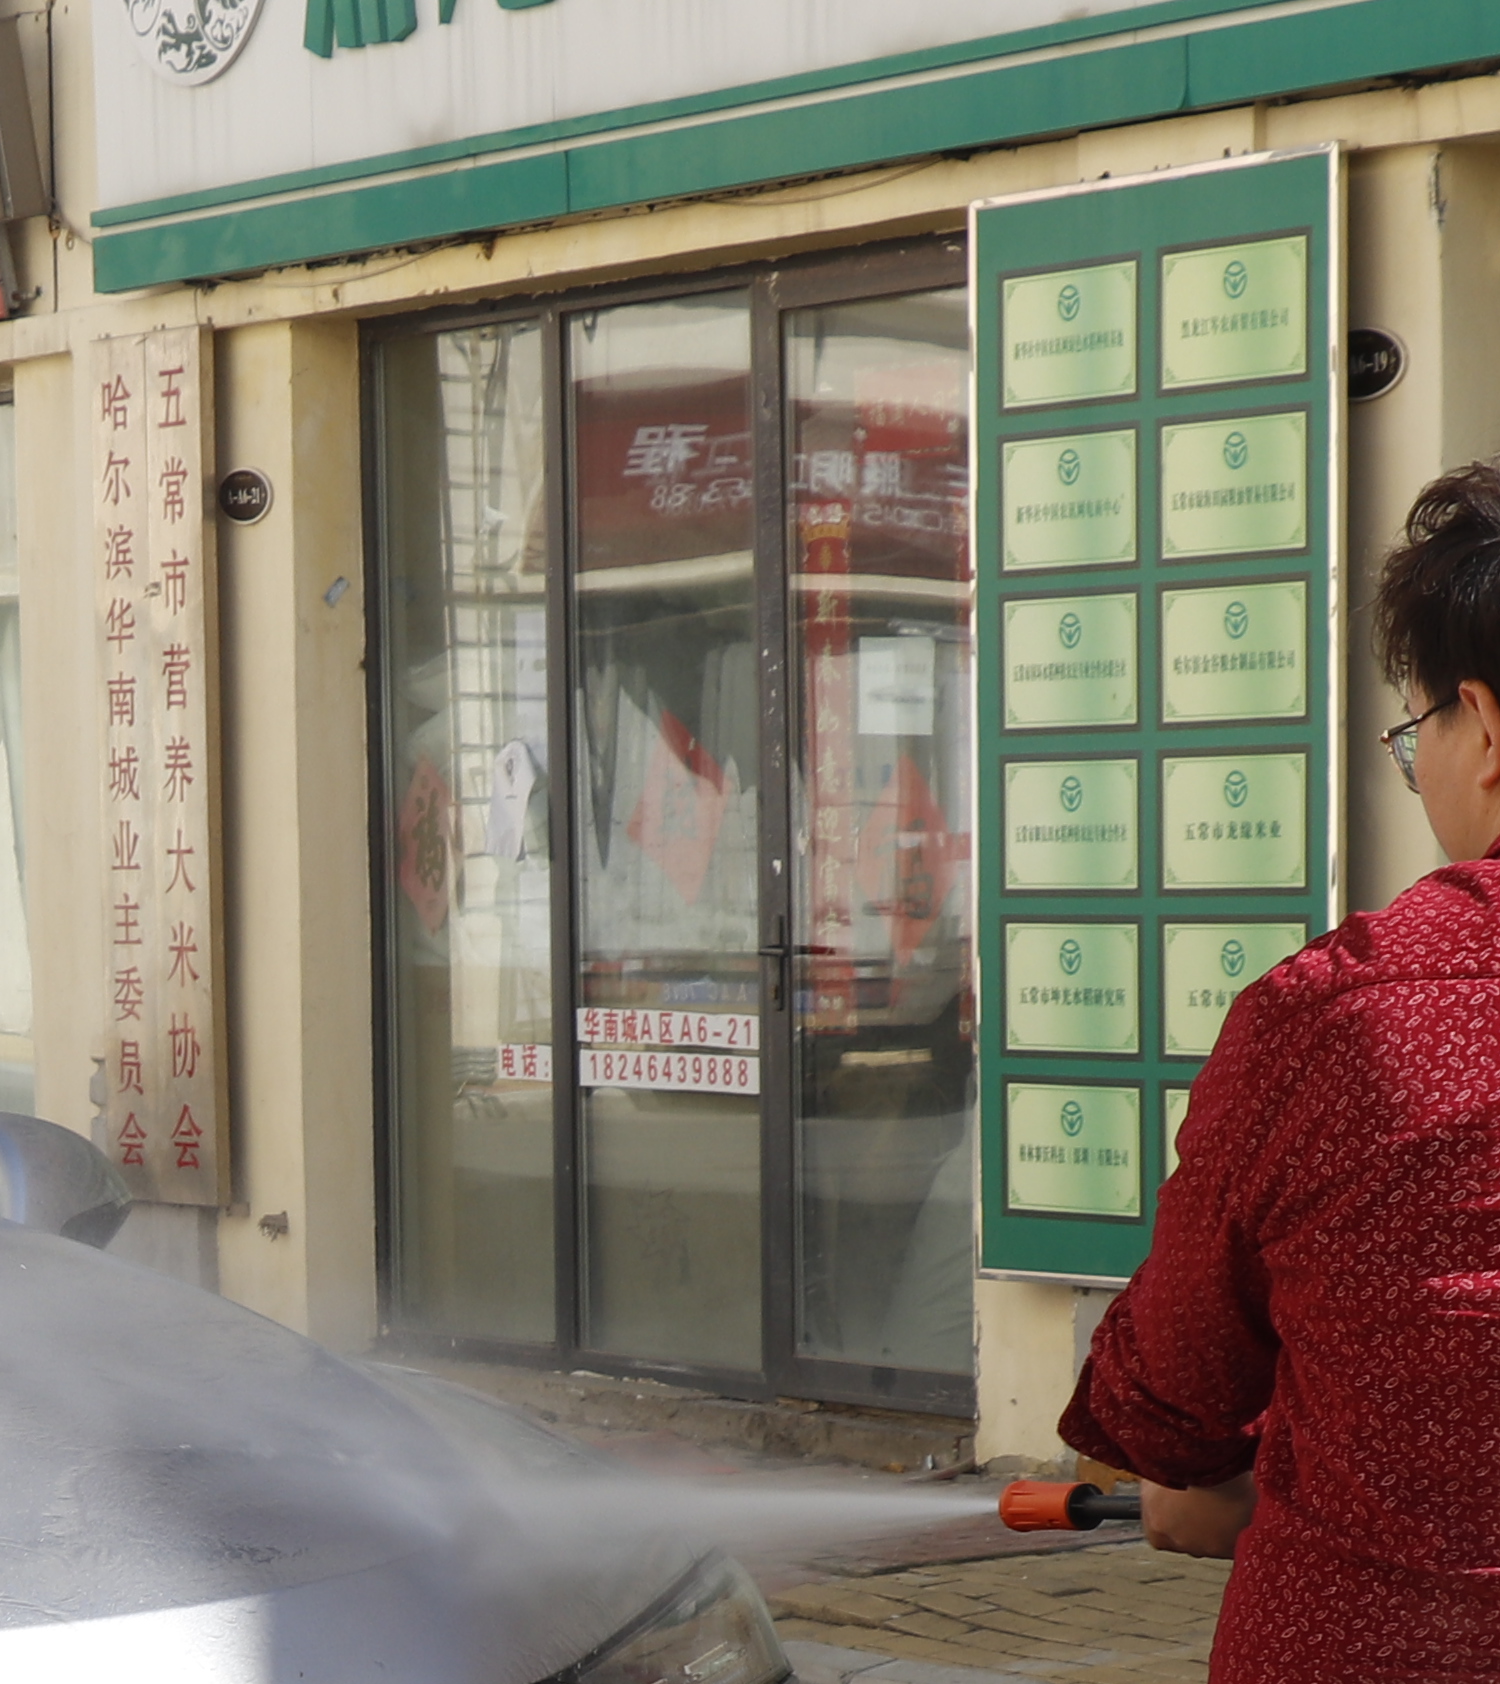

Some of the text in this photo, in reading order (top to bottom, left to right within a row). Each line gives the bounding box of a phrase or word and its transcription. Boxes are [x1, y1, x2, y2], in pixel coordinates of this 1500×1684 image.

[100, 373, 149, 1167] 哈尔滨华南城业主委员会
[157, 364, 203, 1169] 五常市营养大米协会
[583, 1007, 753, 1046] 华南城A区A6-21
[590, 1053, 750, 1088] 18246439888
